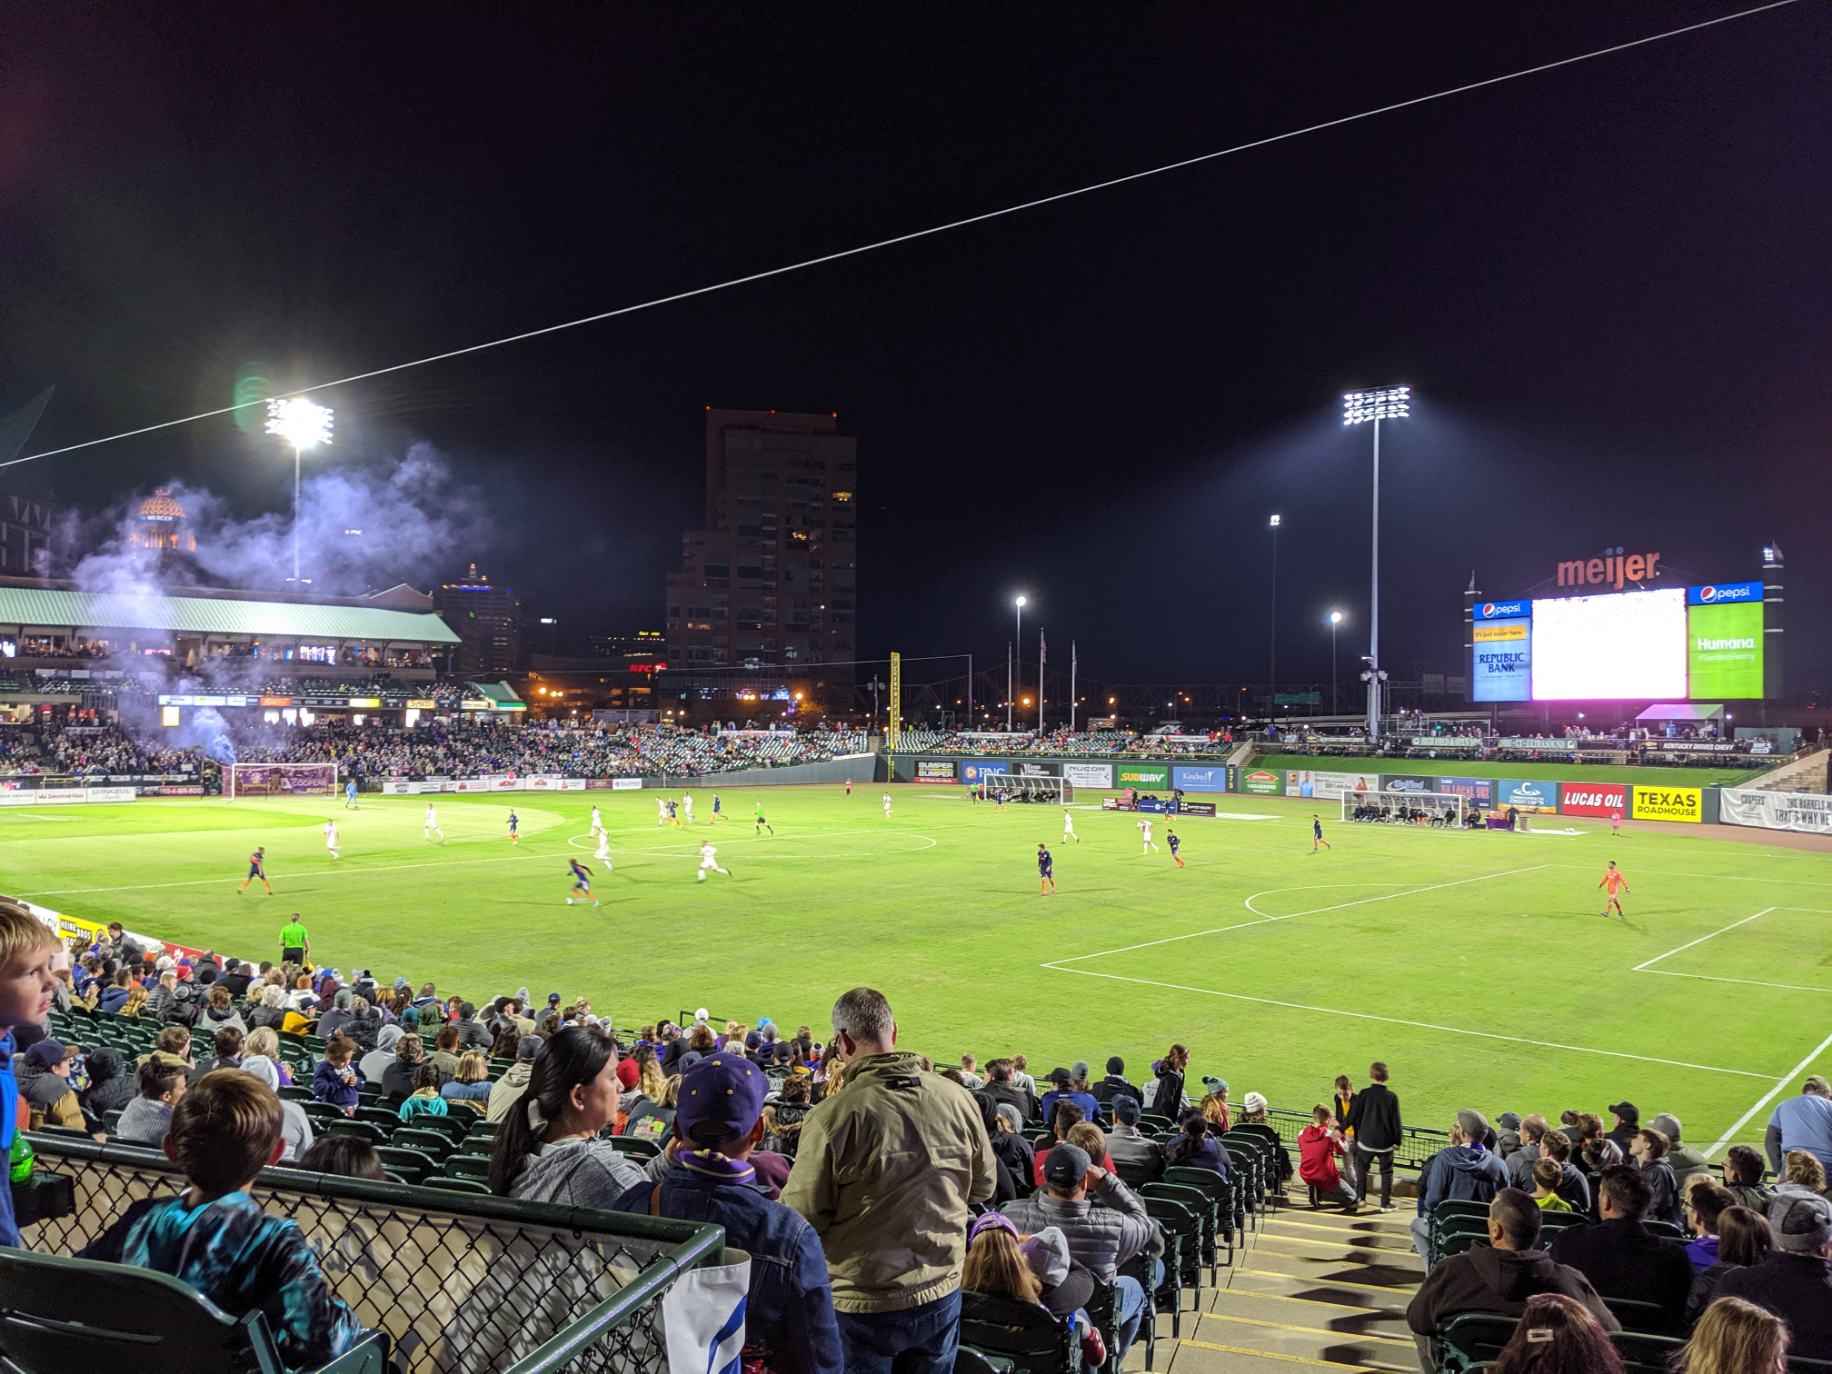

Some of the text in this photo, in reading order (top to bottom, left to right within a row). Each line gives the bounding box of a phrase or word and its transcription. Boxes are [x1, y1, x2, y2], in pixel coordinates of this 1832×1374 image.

[1557, 546, 1660, 590] meijer
[1717, 586, 1751, 600] pepsi
[1495, 603, 1521, 615] pepsi
[1697, 637, 1755, 650] Humana
[1479, 652, 1525, 664] REPUBLIC
[630, 664, 651, 672] KFC
[1488, 663, 1516, 673] BANK
[978, 767, 1005, 778] PNC
[1120, 773, 1165, 782] SUBWAY
[1564, 792, 1624, 808] LUCAS OIL
[1638, 792, 1697, 808] TEXAS
[1787, 798, 1798, 808] THE
[1799, 799, 1825, 811] BARRELS
[1637, 806, 1697, 817] ROADHOUSE
[1775, 808, 1800, 822] THAT'S
[1800, 810, 1818, 824] WHY
